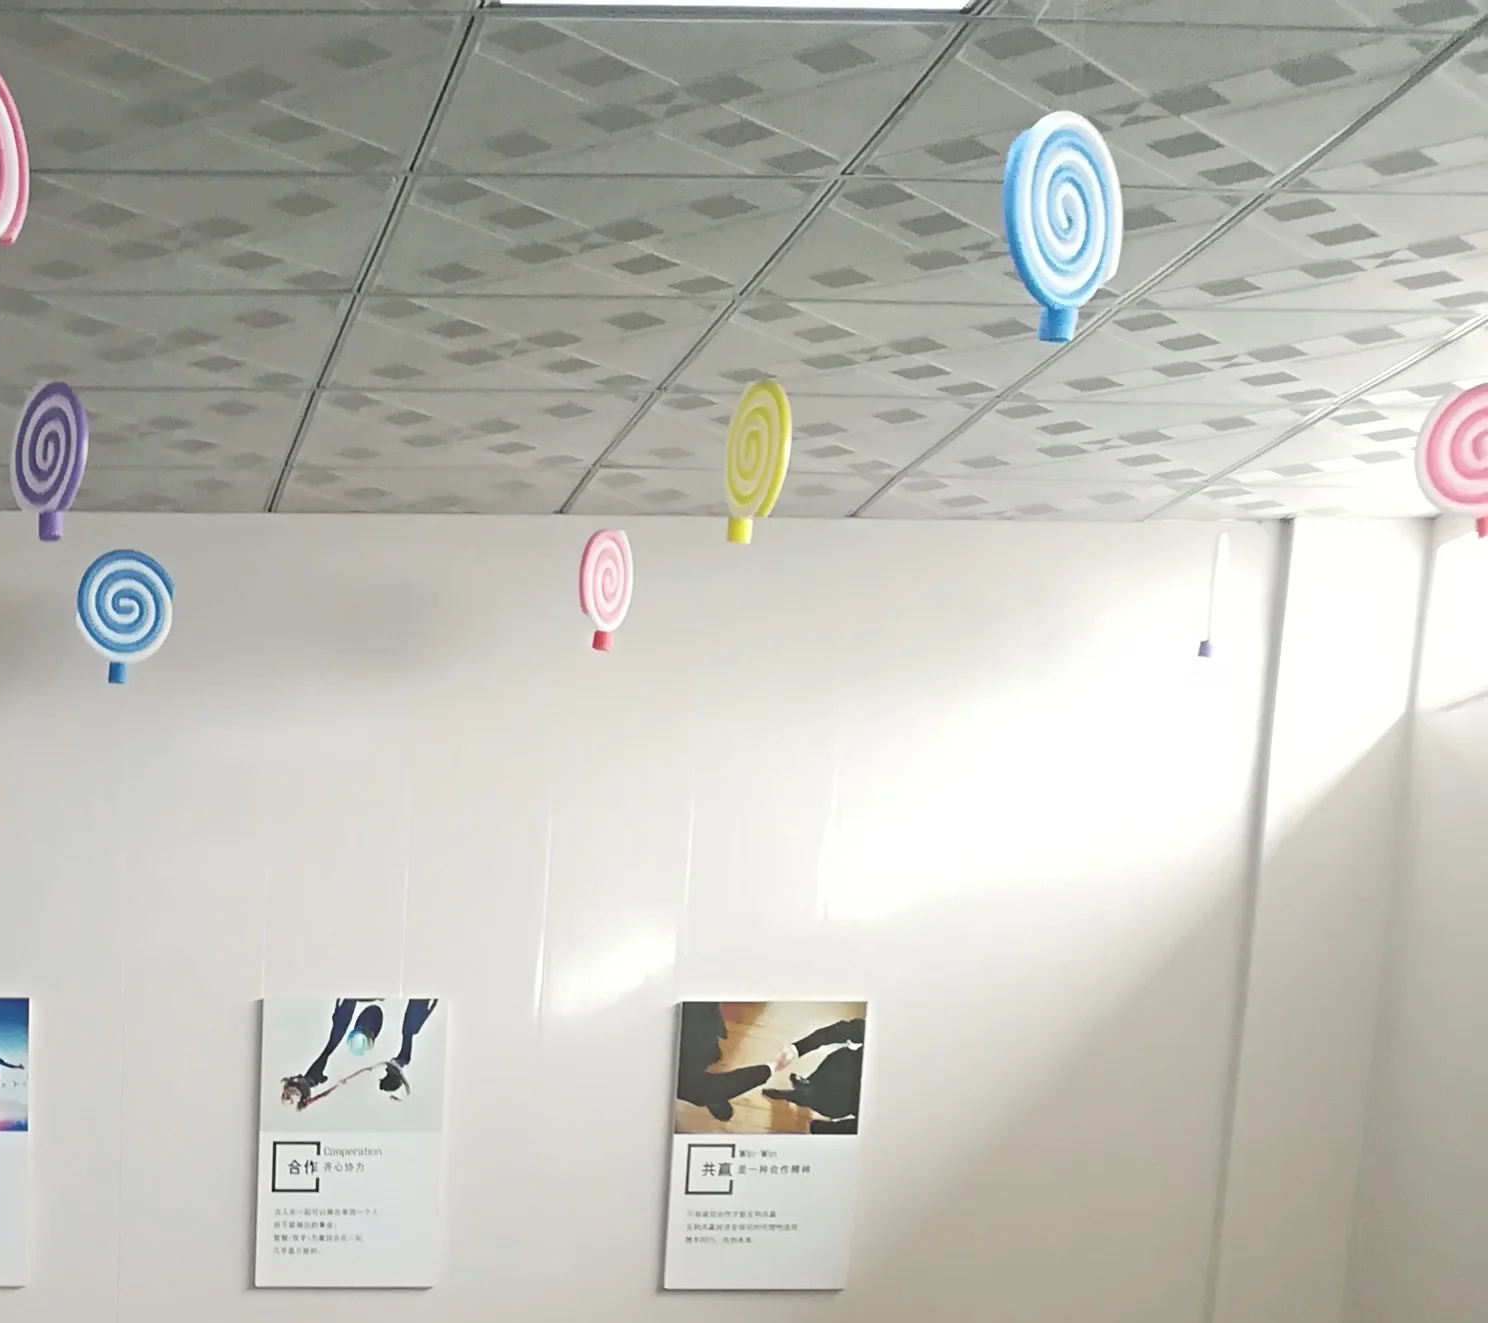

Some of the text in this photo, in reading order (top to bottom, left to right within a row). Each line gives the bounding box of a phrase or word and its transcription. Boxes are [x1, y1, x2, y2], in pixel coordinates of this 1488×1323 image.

[323, 1146, 382, 1158] Cooperation
[288, 1159, 318, 1175] 合作
[701, 1161, 733, 1177] 共赢
